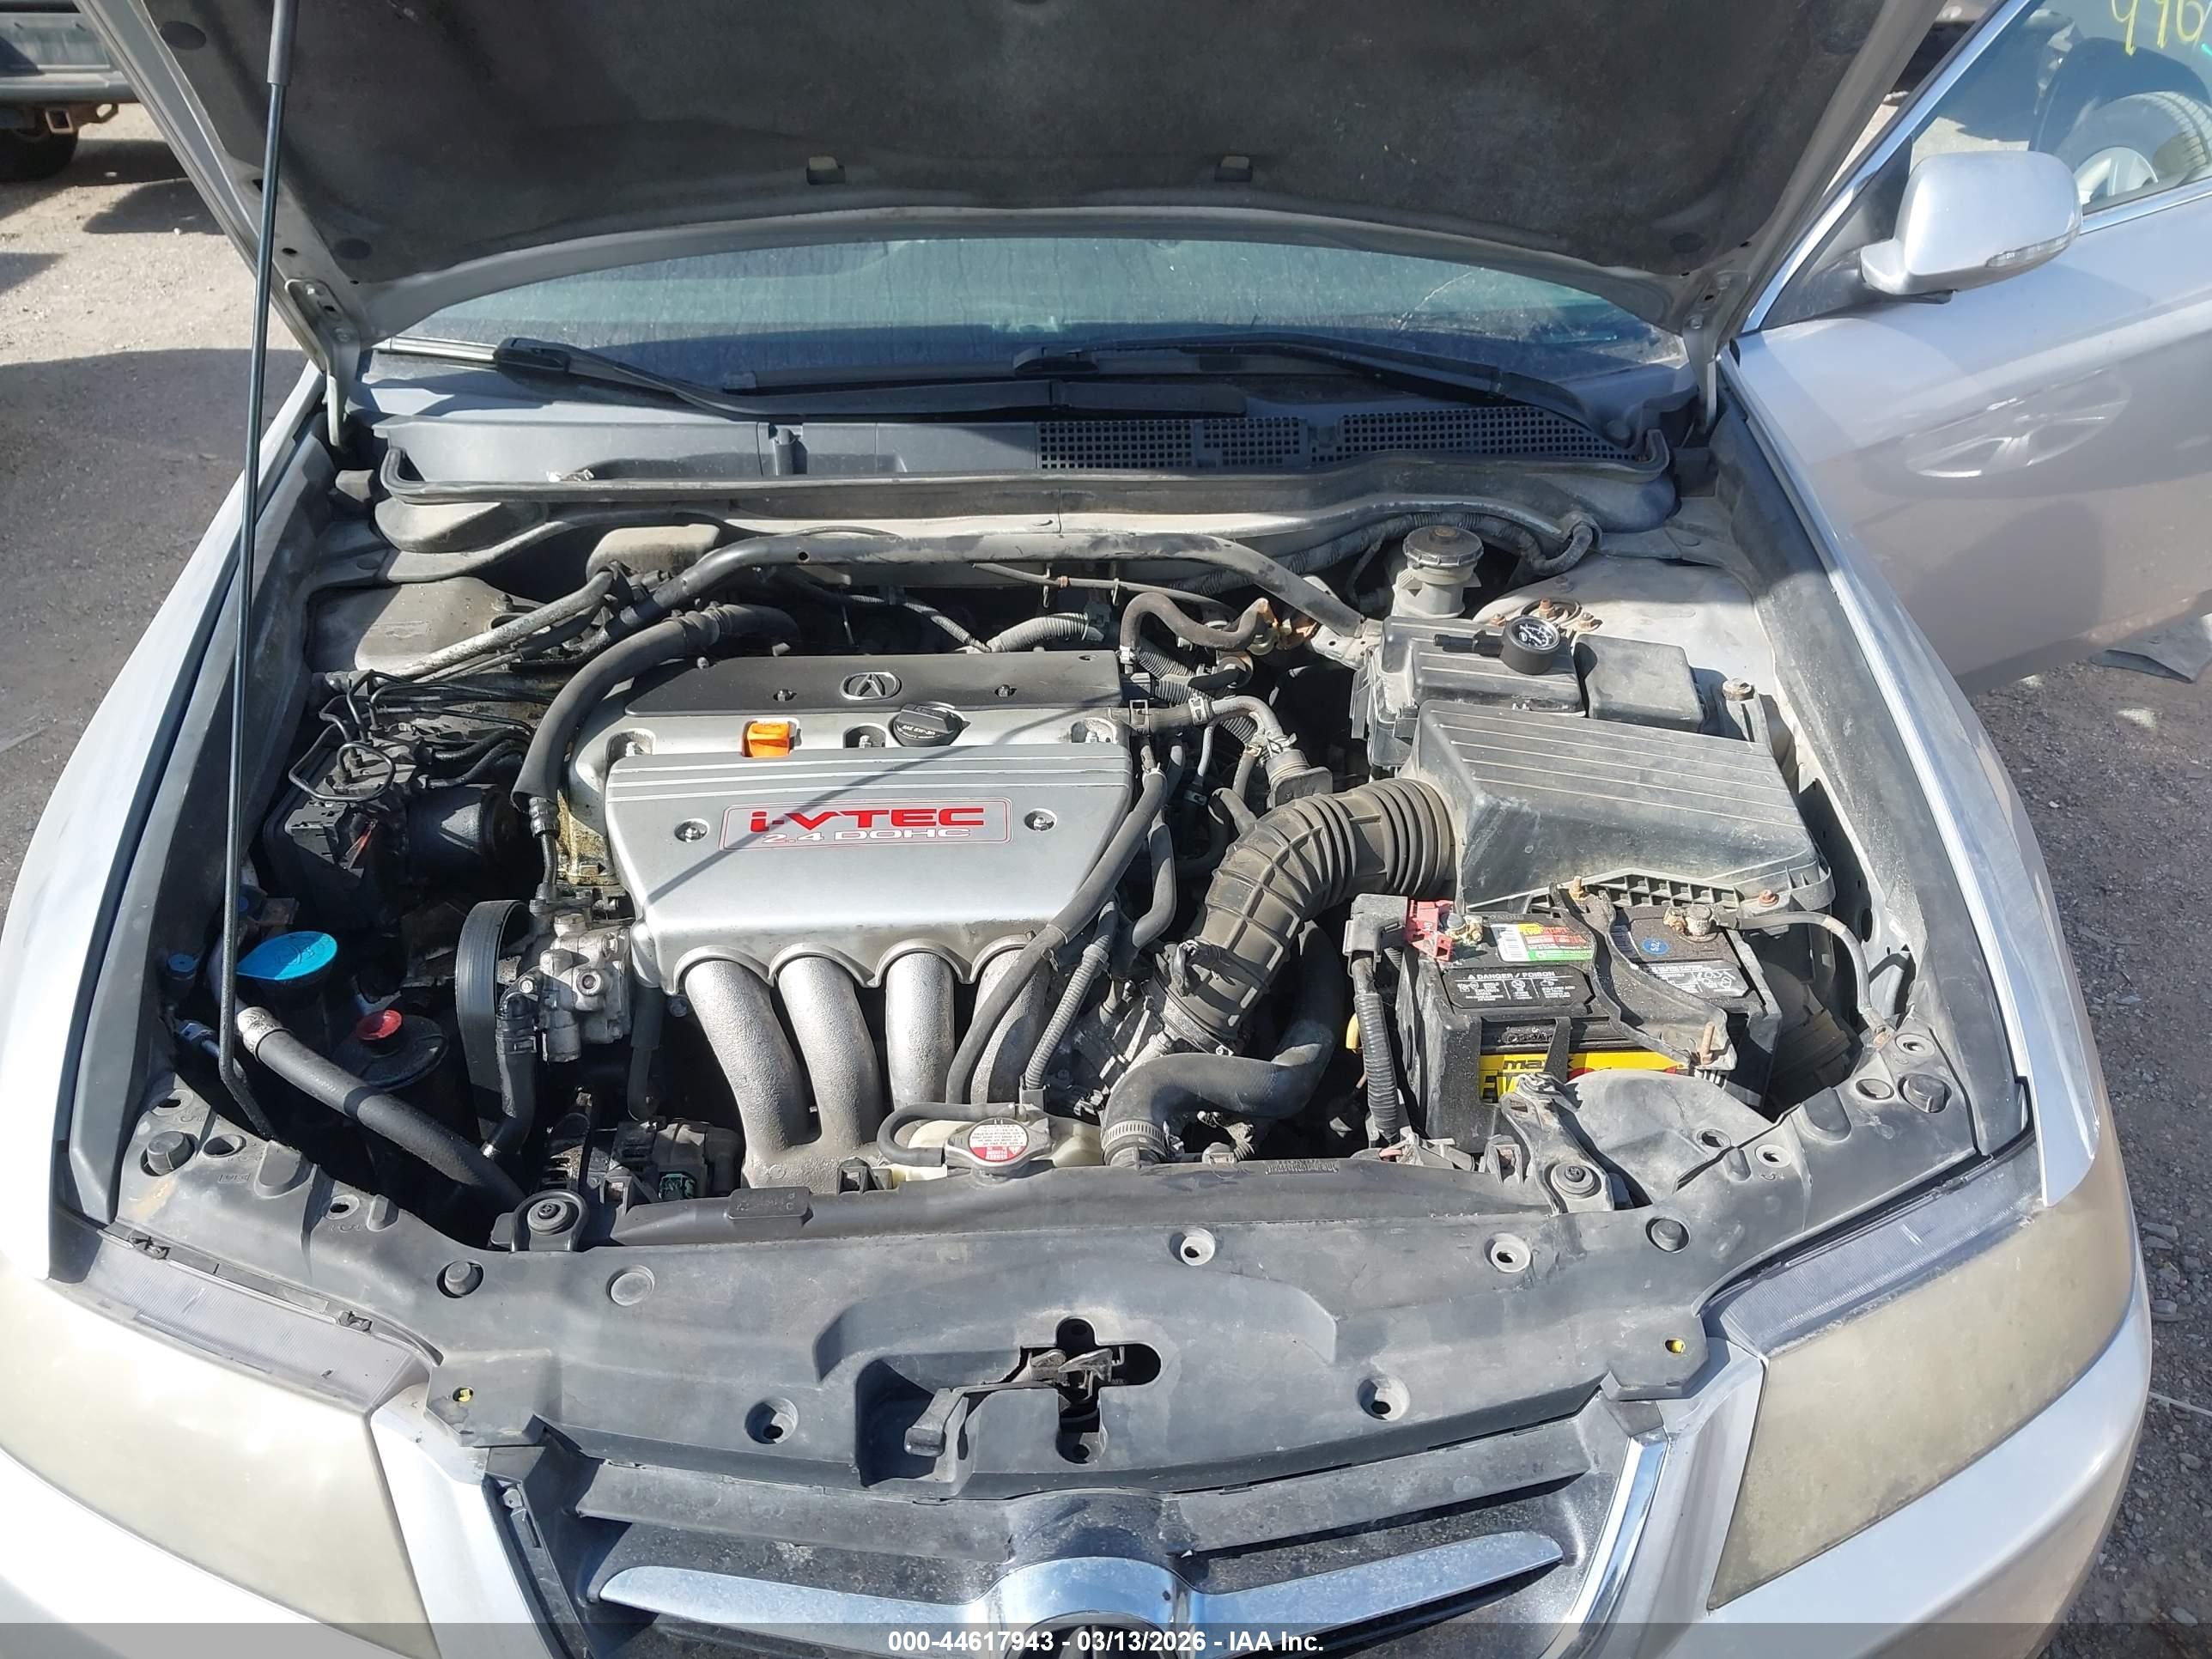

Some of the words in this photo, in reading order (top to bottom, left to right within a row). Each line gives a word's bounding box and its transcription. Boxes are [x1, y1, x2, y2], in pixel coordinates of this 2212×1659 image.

[750, 807, 985, 832] i-VTEC
[762, 831, 825, 844] 2.4
[834, 828, 971, 842] DOHC
